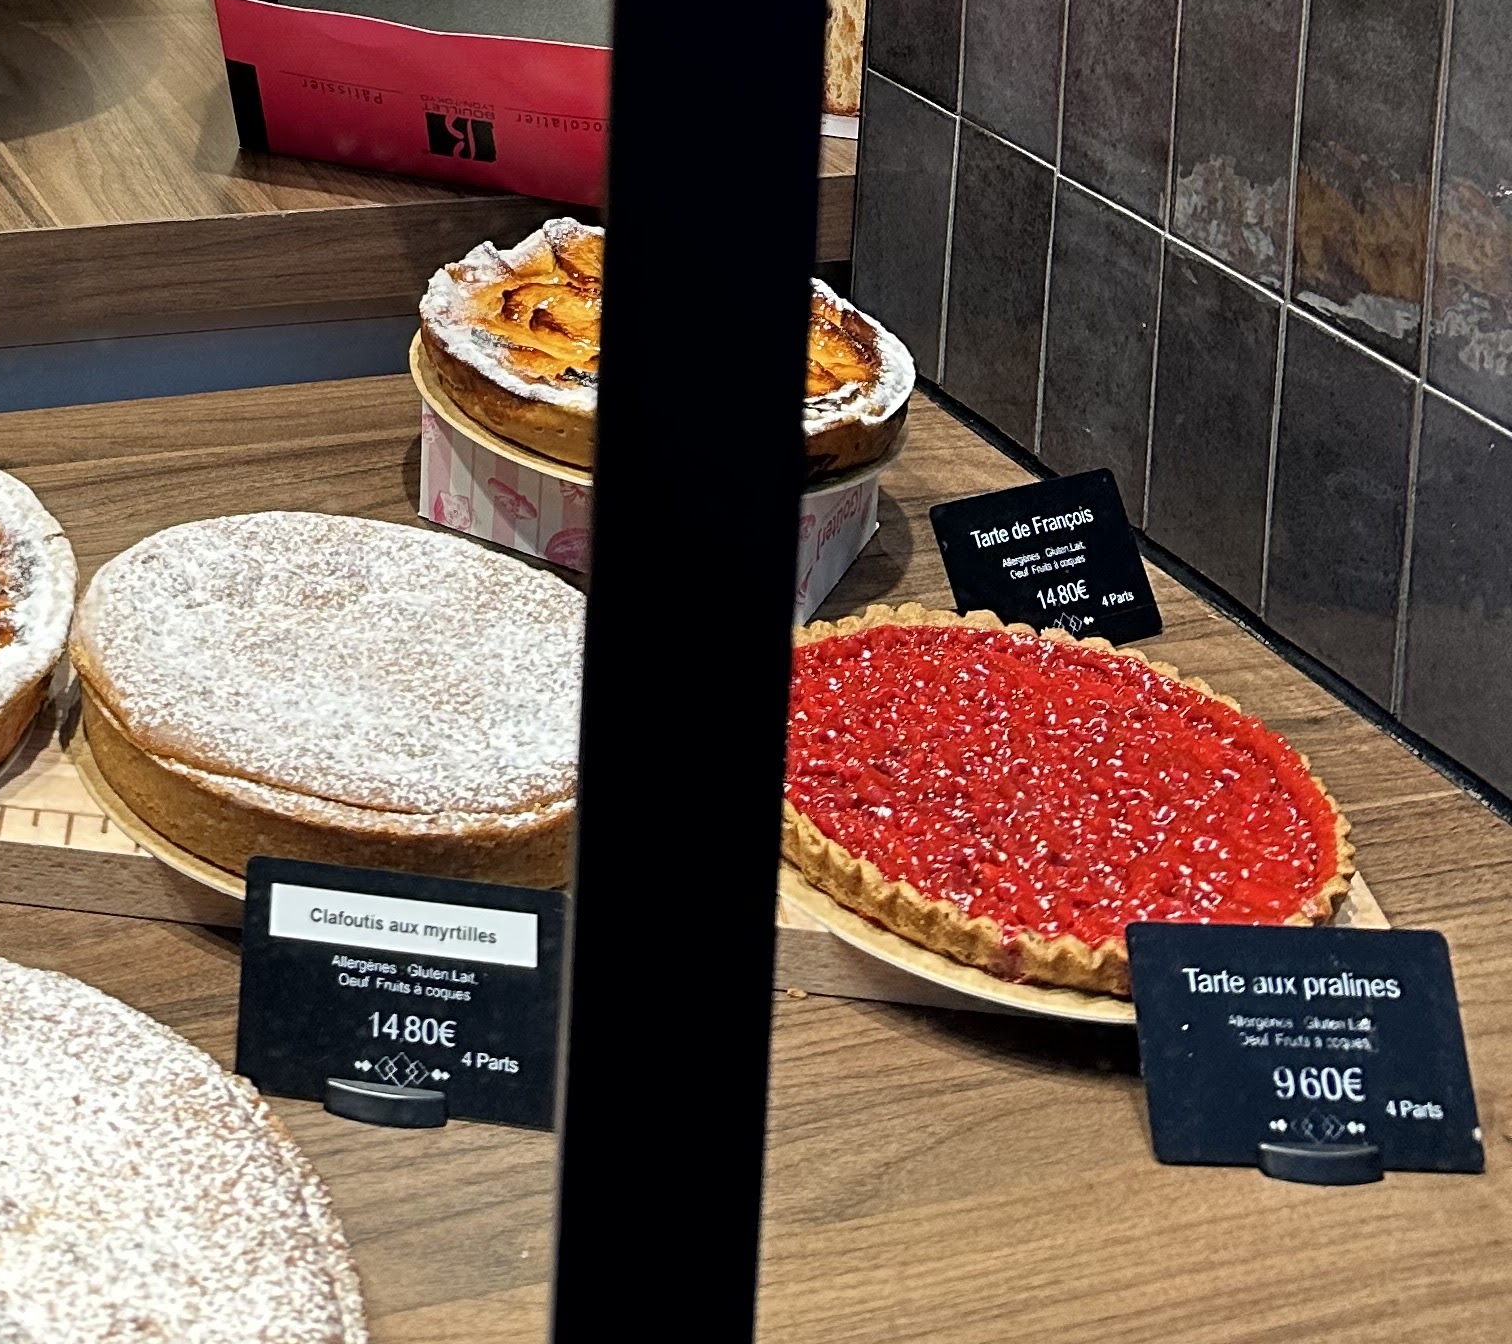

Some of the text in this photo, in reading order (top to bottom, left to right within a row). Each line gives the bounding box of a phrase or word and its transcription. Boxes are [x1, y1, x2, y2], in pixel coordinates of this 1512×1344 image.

[423, 103, 496, 120] BOUILLET
[516, 113, 608, 133] ocolatier
[970, 506, 1094, 549] Tarte de François
[1101, 590, 1135, 608] 4 Parts
[310, 907, 497, 944] Clafoutis aux myrtilles
[375, 977, 411, 994] Fruits
[413, 982, 422, 996] à
[425, 986, 471, 1001] coques
[1181, 968, 1402, 1001] Tarte aux pralines
[461, 1051, 519, 1074] 4 Parts
[1386, 1100, 1444, 1120] 4 Parts
